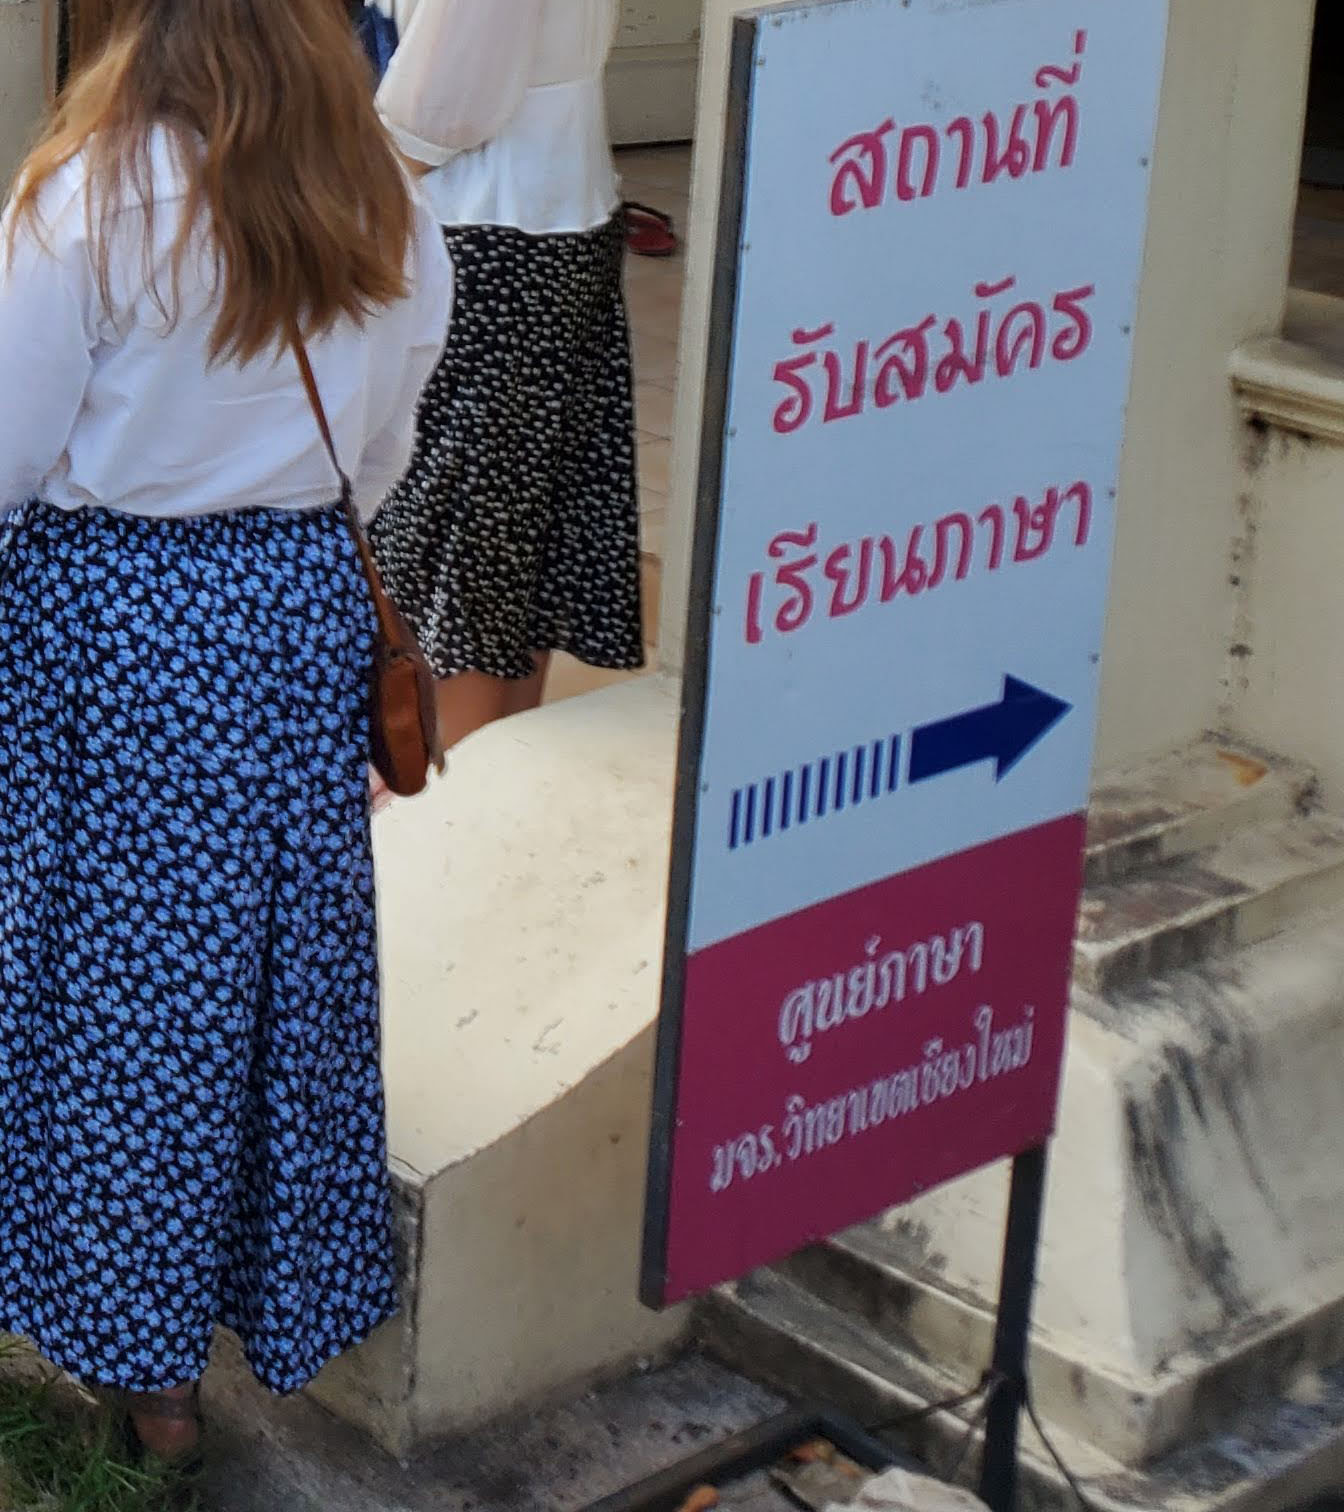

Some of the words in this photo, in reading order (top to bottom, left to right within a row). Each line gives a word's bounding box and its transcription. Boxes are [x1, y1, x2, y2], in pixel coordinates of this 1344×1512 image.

[828, 30, 1089, 218] สถานที่
[772, 275, 1095, 434] รับสมัคร
[744, 480, 1094, 644] เรียนภาษา
[777, 919, 985, 1064] ศูนย์ภาษา
